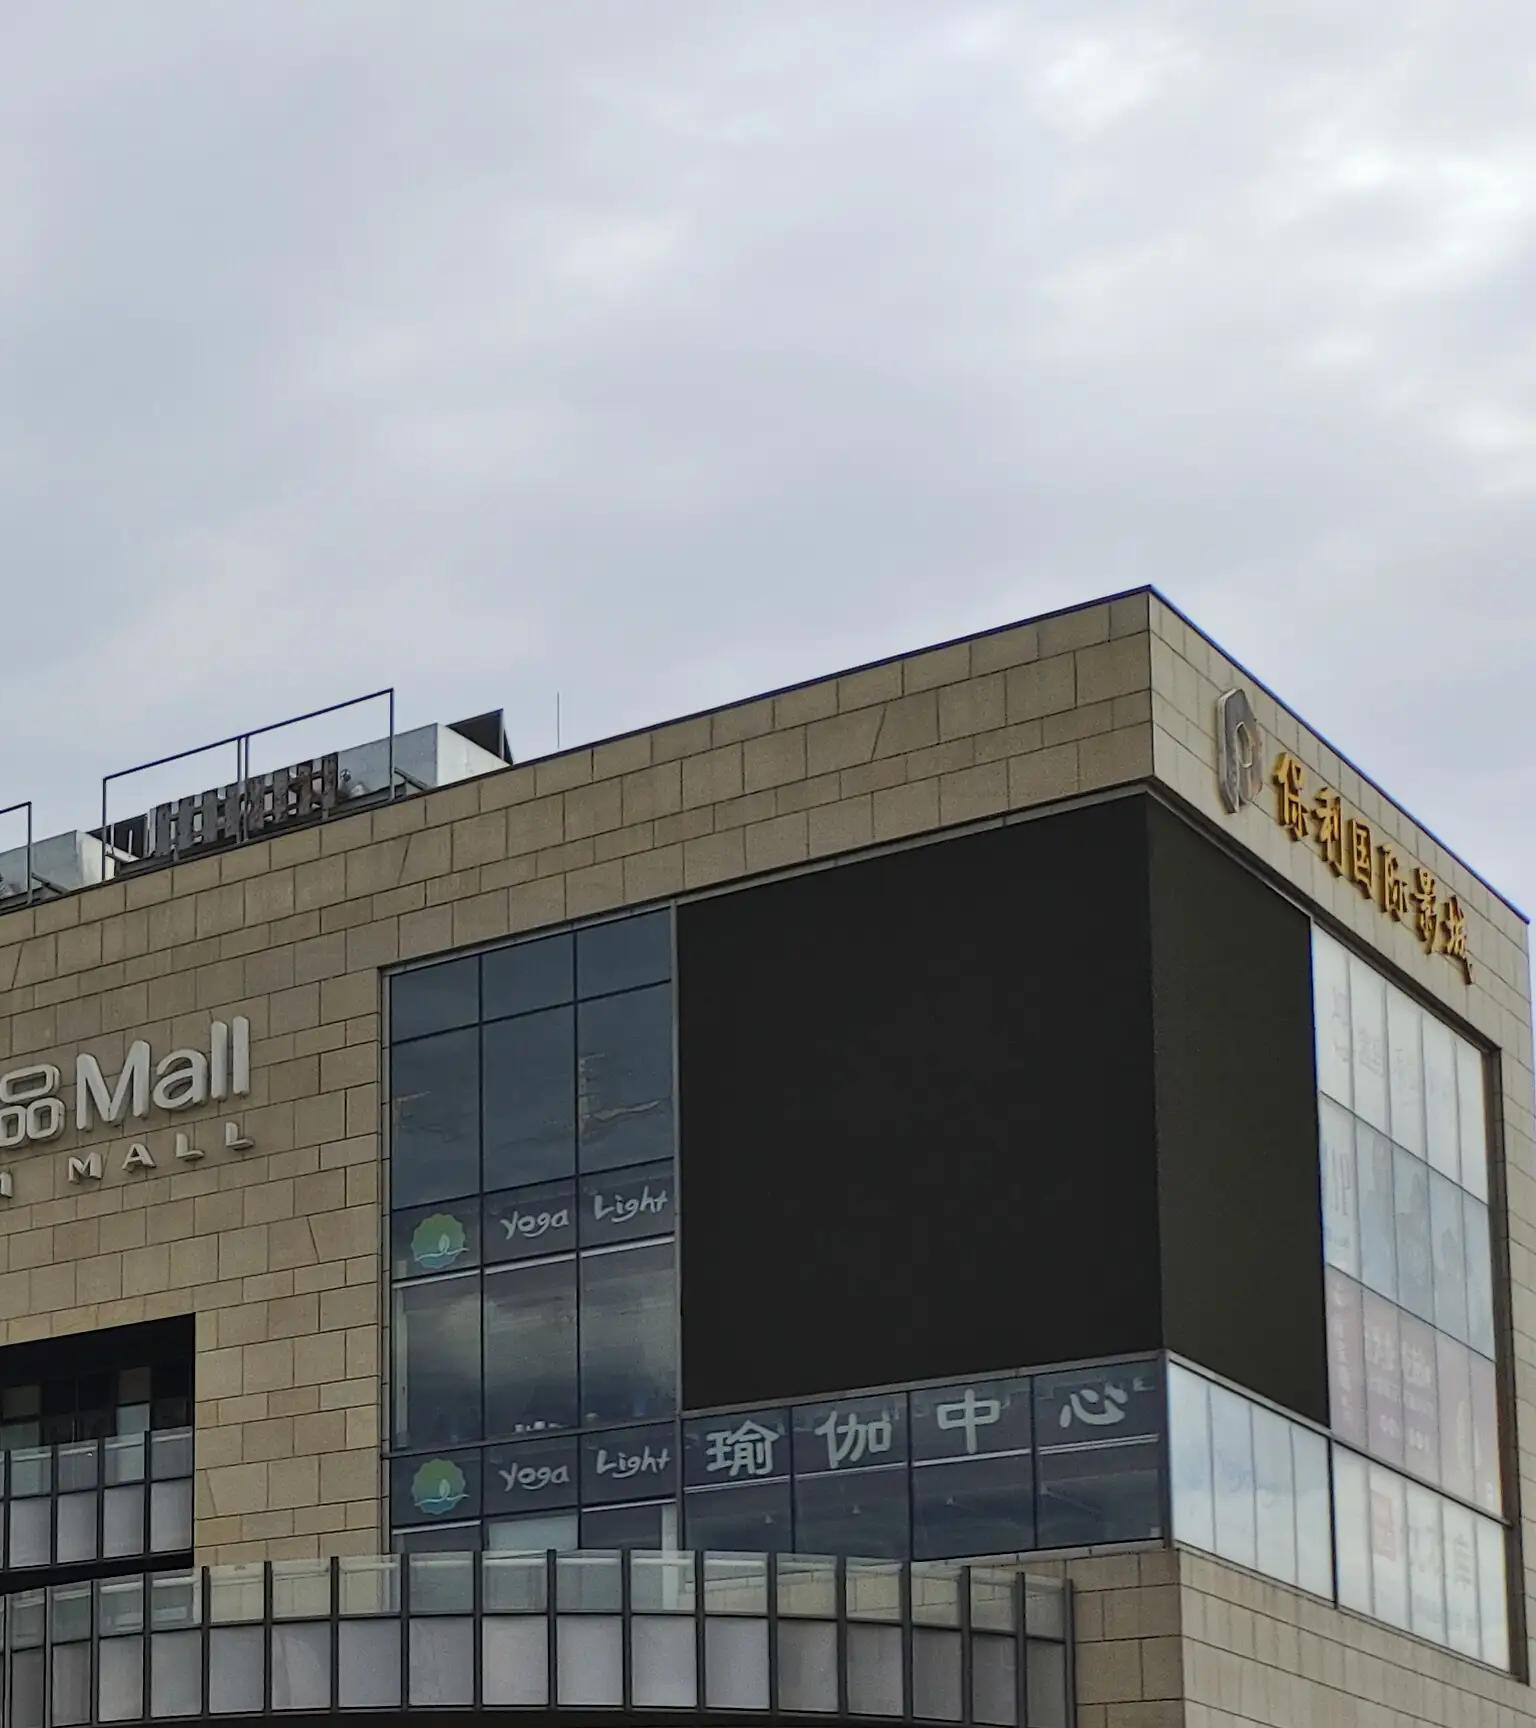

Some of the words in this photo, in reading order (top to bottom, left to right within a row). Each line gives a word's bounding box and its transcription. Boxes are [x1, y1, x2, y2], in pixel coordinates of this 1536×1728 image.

[1272, 752, 1472, 984] 保利国际影城
[67, 1121, 256, 1185] MALL
[593, 1186, 669, 1223] Light
[596, 1447, 671, 1479] Light
[705, 1388, 1128, 1477] 瑜伽中心
